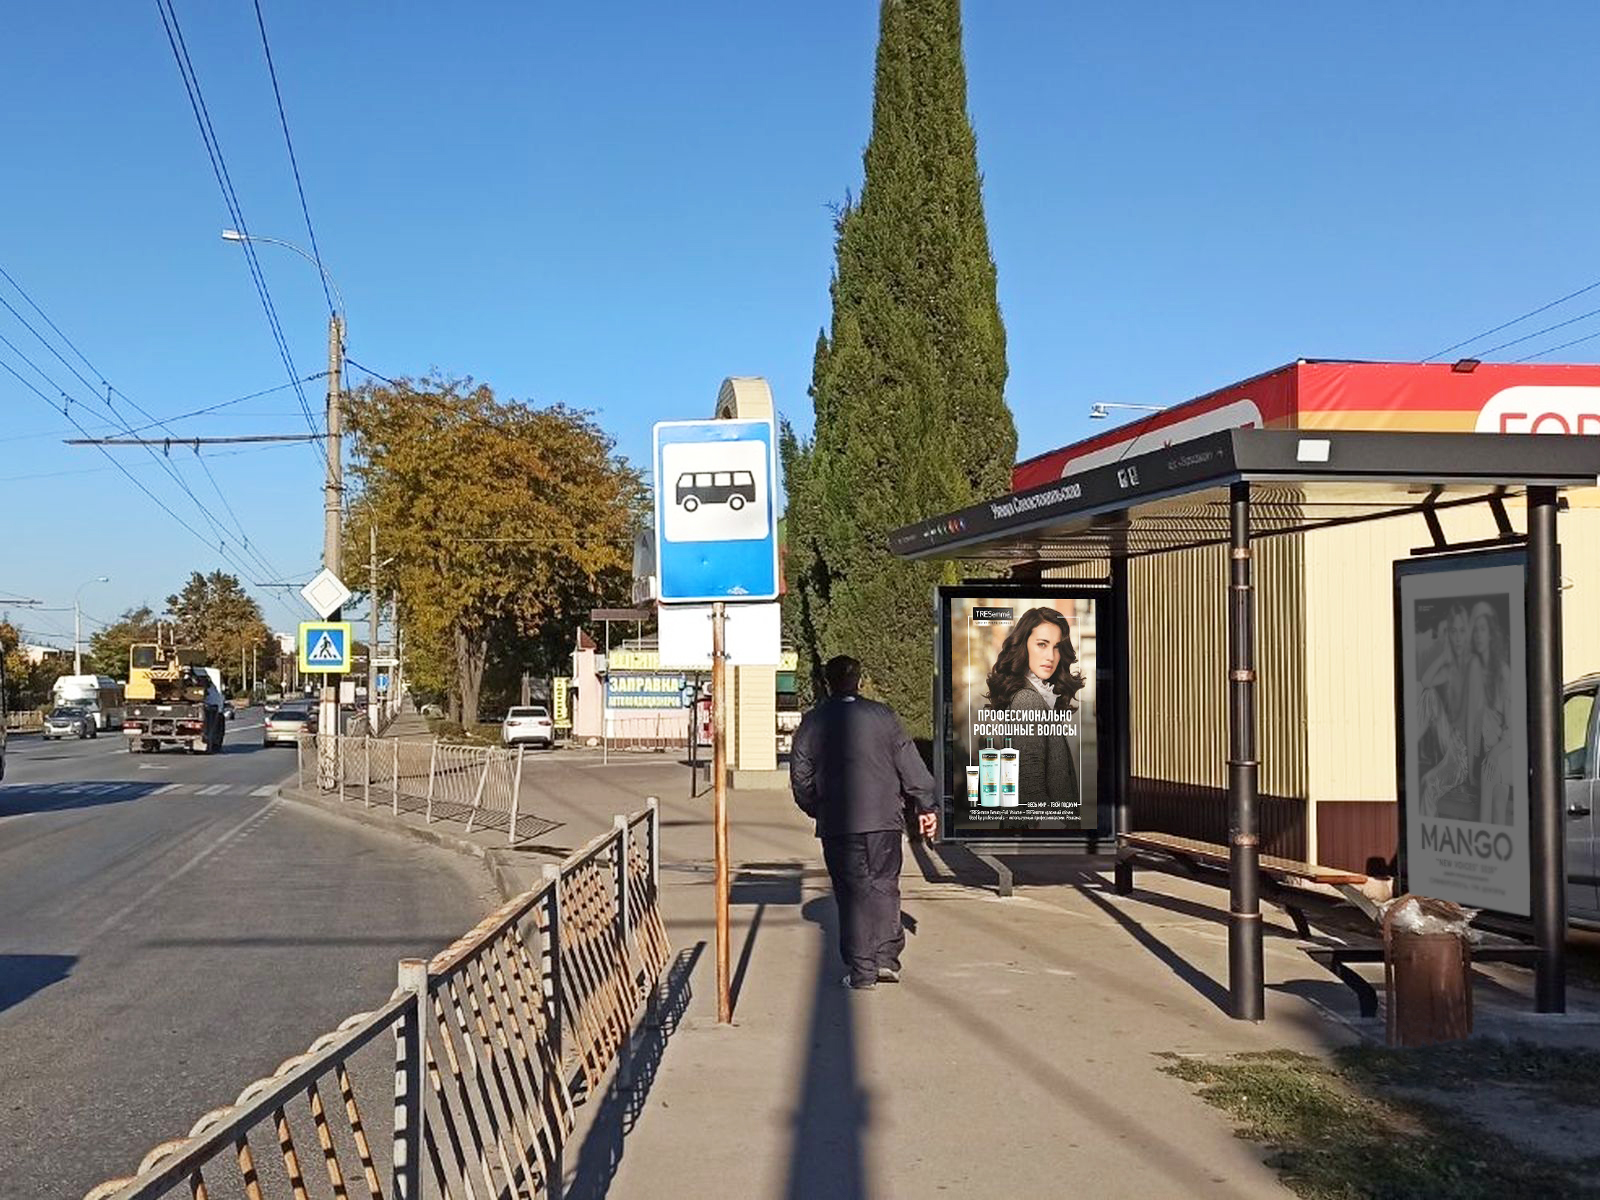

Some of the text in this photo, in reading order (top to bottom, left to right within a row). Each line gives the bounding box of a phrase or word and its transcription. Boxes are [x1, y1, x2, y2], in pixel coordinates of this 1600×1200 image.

[978, 709, 1072, 722] ПРОФЕССИОНАЛЬНО
[973, 723, 1077, 736] РОСКОШНЫЕ ВОЛОСЫ
[1421, 822, 1513, 862] MANGO
